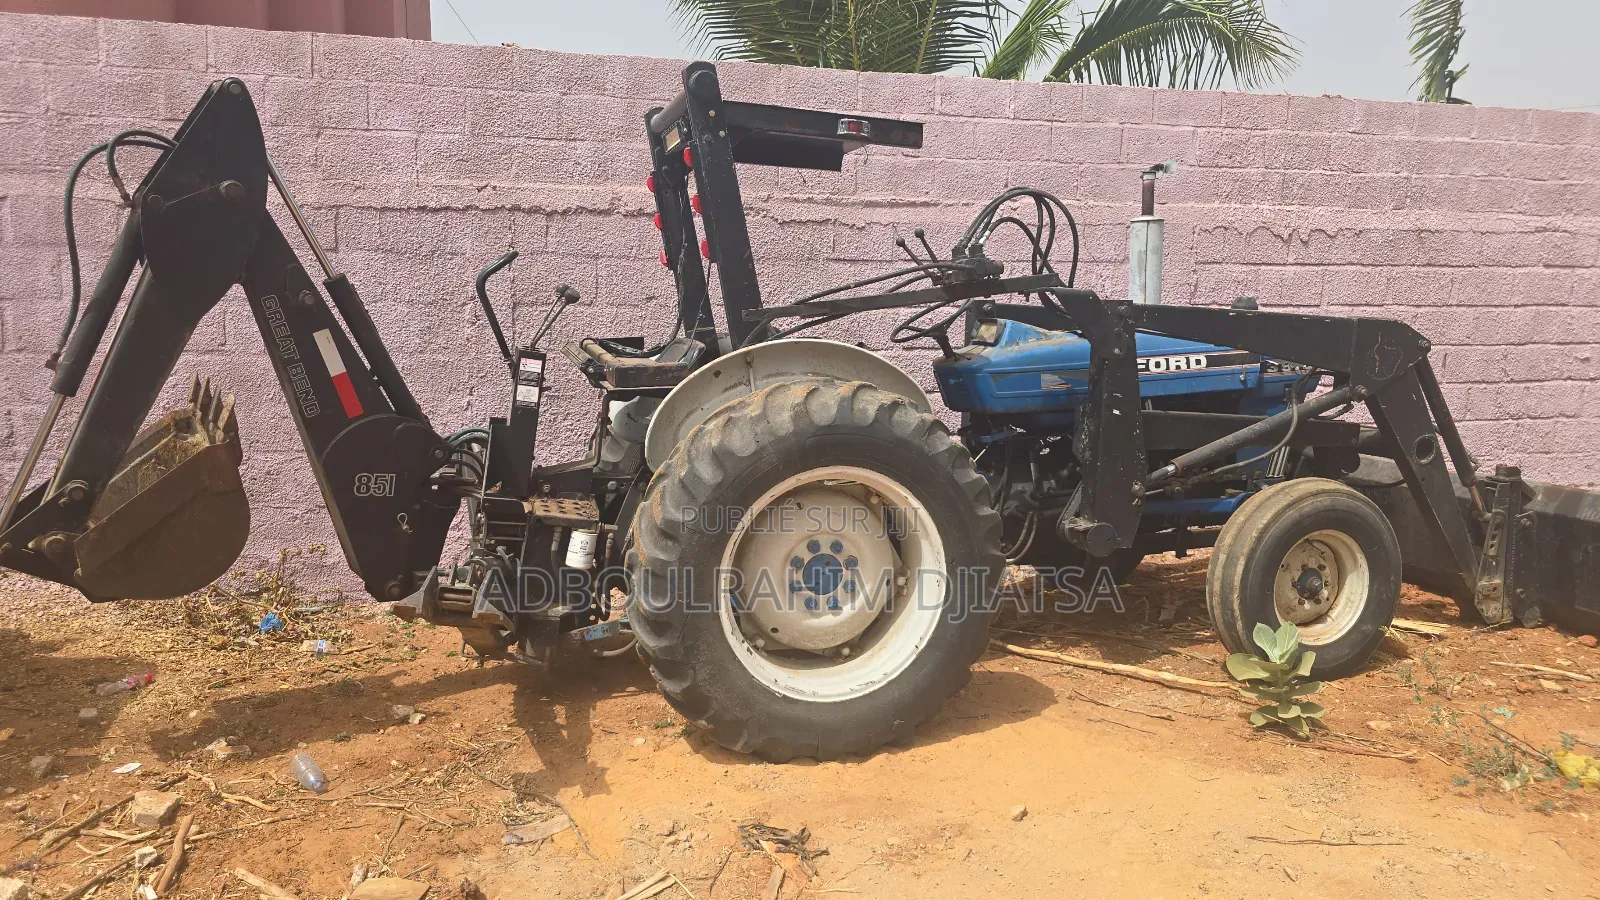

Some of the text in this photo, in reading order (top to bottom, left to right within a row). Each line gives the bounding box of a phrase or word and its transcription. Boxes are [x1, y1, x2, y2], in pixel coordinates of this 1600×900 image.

[261, 294, 321, 418] GREAT BEND
[1136, 355, 1207, 372] FORD
